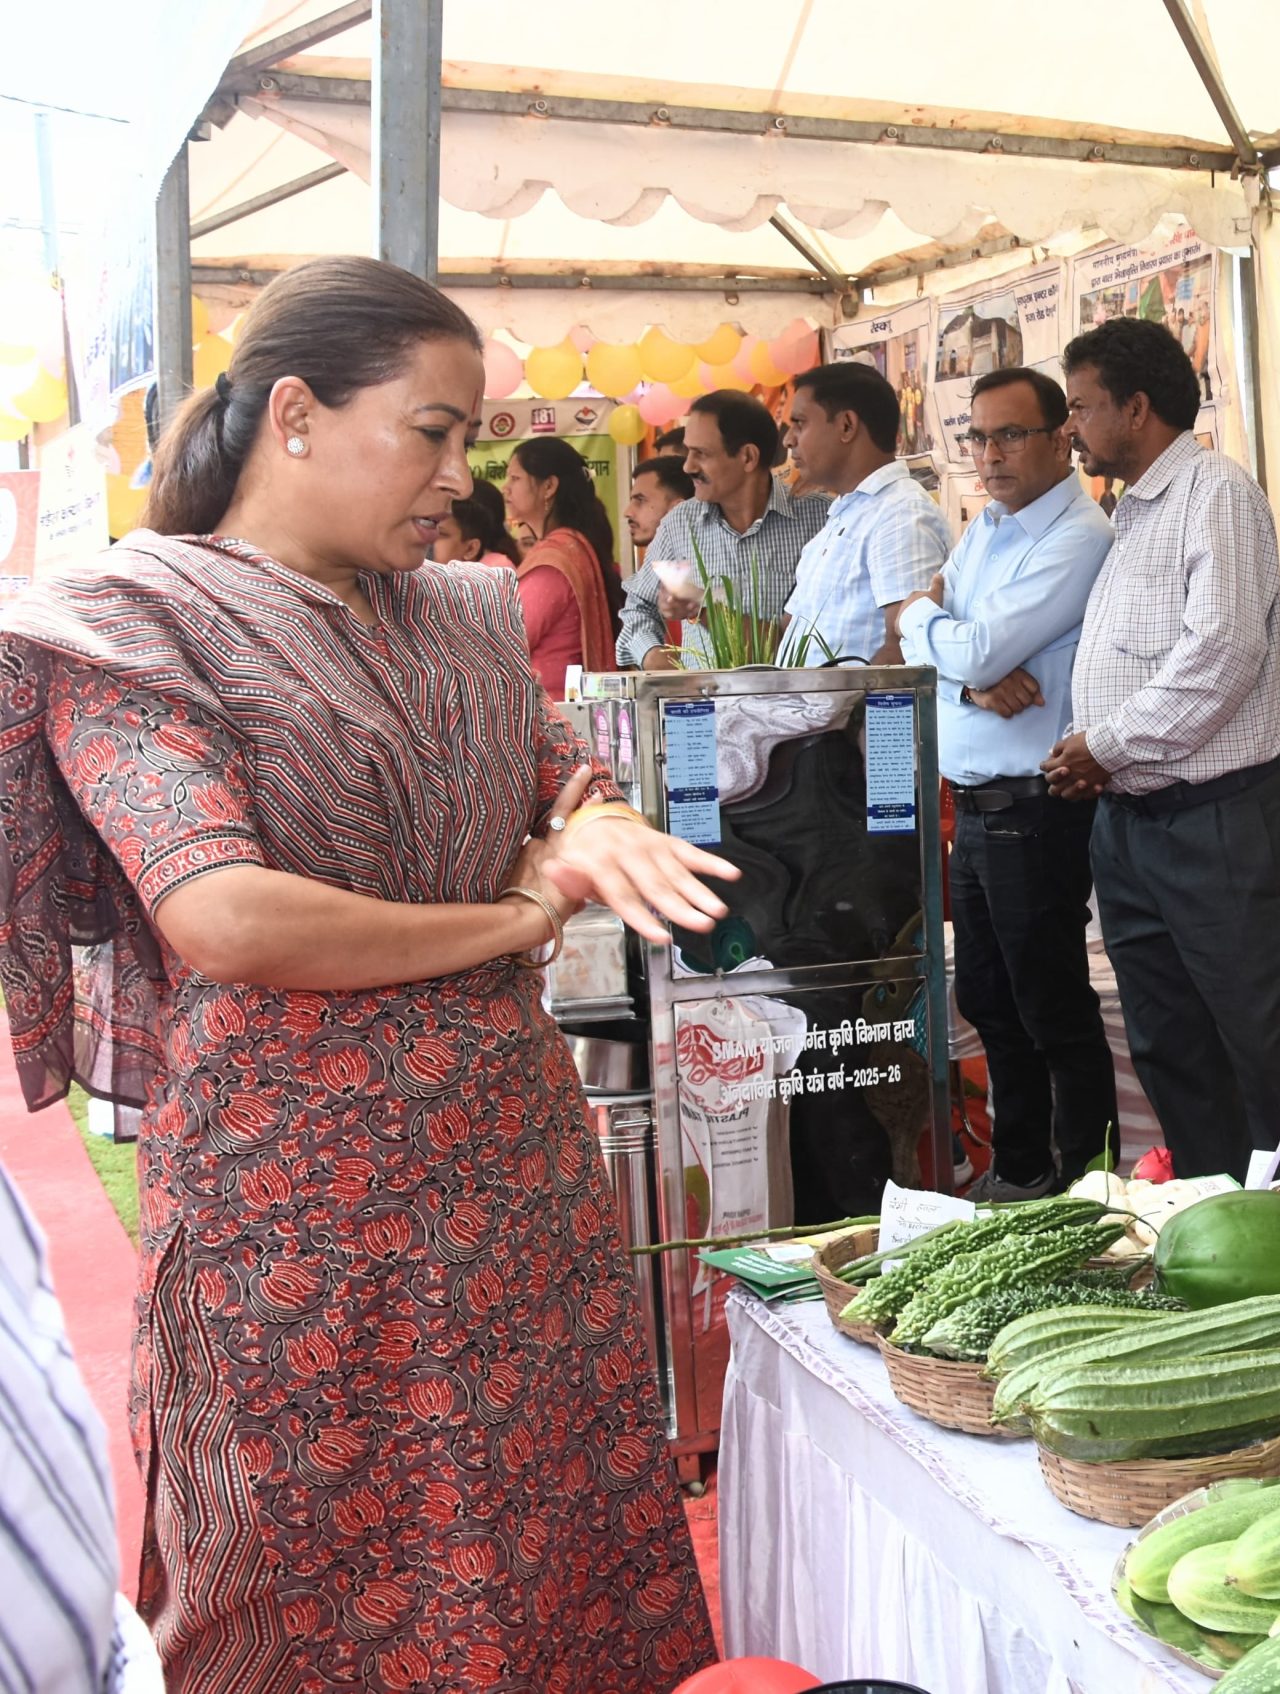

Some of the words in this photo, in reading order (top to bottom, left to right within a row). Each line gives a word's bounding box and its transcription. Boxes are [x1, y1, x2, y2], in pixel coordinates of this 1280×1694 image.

[534, 408, 554, 423] 181
[712, 1039, 758, 1060] SMAM
[828, 1019, 853, 1056] कृषि
[855, 1017, 891, 1046] विभाग
[893, 1019, 915, 1043] द्वारा
[720, 1073, 777, 1112] अनुदानित
[779, 1068, 804, 1105] कृषि
[806, 1067, 825, 1093] यंत्र
